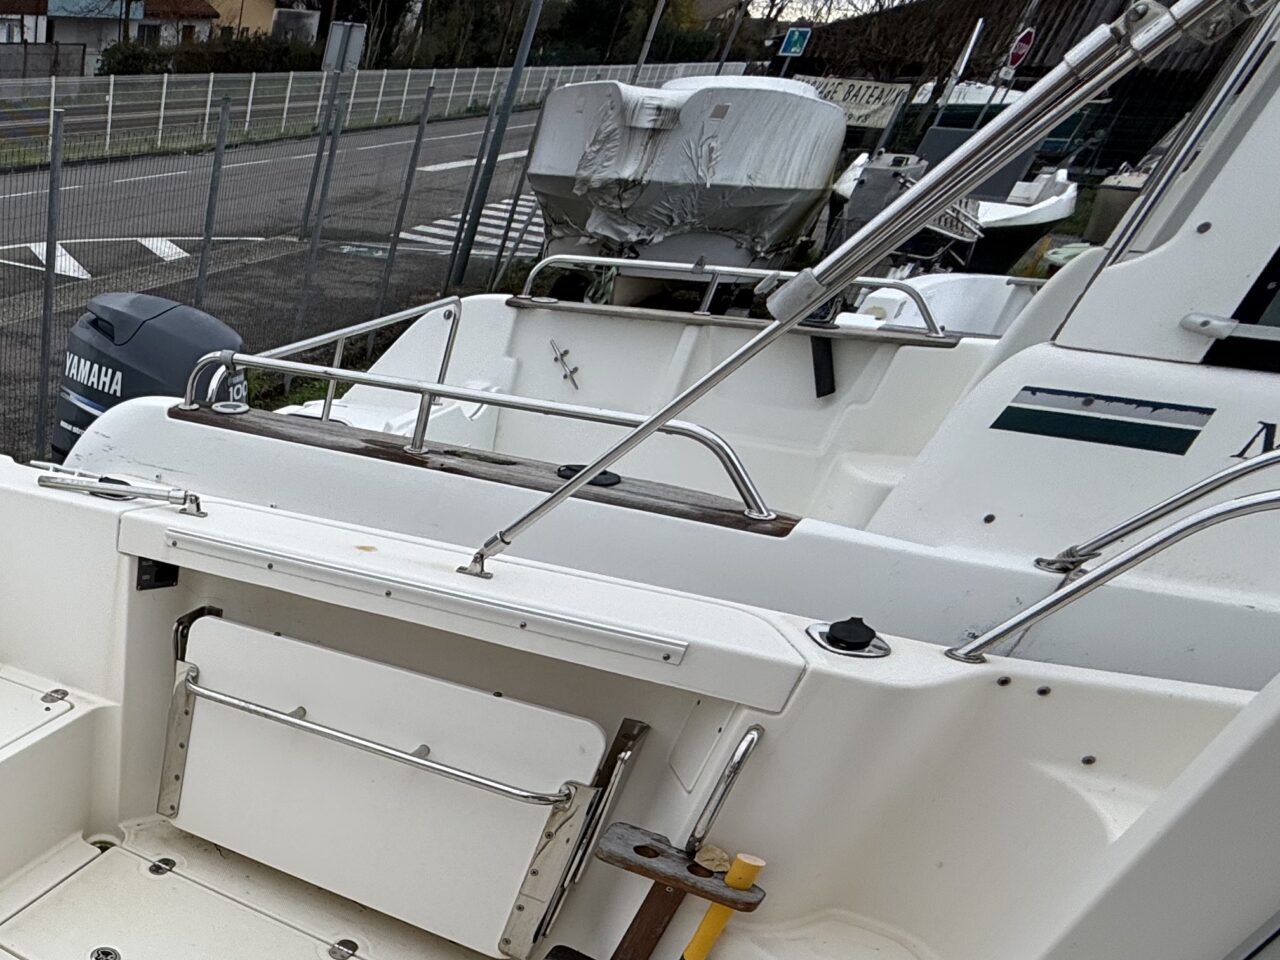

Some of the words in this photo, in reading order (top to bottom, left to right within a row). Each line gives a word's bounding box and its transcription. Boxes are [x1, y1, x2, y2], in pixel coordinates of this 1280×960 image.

[842, 83, 904, 106] BATEAUX
[65, 351, 122, 397] YAMAHA
[229, 380, 248, 402] 100
